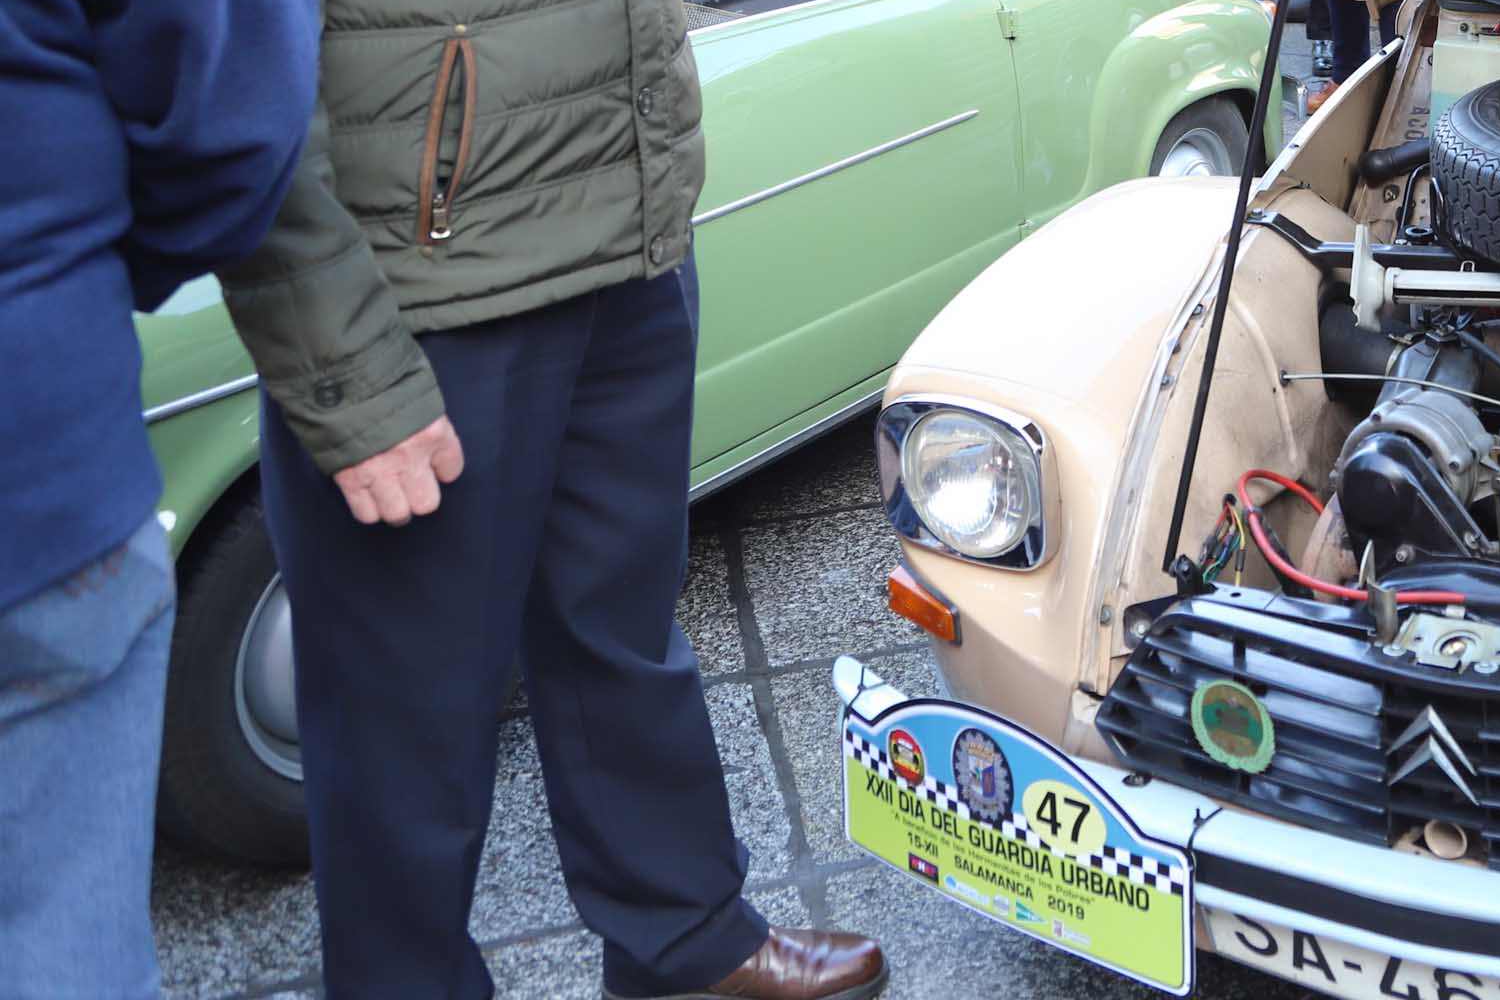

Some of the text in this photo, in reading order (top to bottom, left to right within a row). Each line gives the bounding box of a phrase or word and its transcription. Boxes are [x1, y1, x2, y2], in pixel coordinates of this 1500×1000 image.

[865, 769, 894, 806] XXII
[898, 789, 925, 823] DIA
[931, 807, 964, 841] DEL
[968, 824, 1054, 880] GUARDIA
[1060, 860, 1151, 913] URBANO
[1036, 791, 1090, 846] 47
[954, 854, 1034, 901] SALAMANCA
[1047, 894, 1085, 922] 2019
